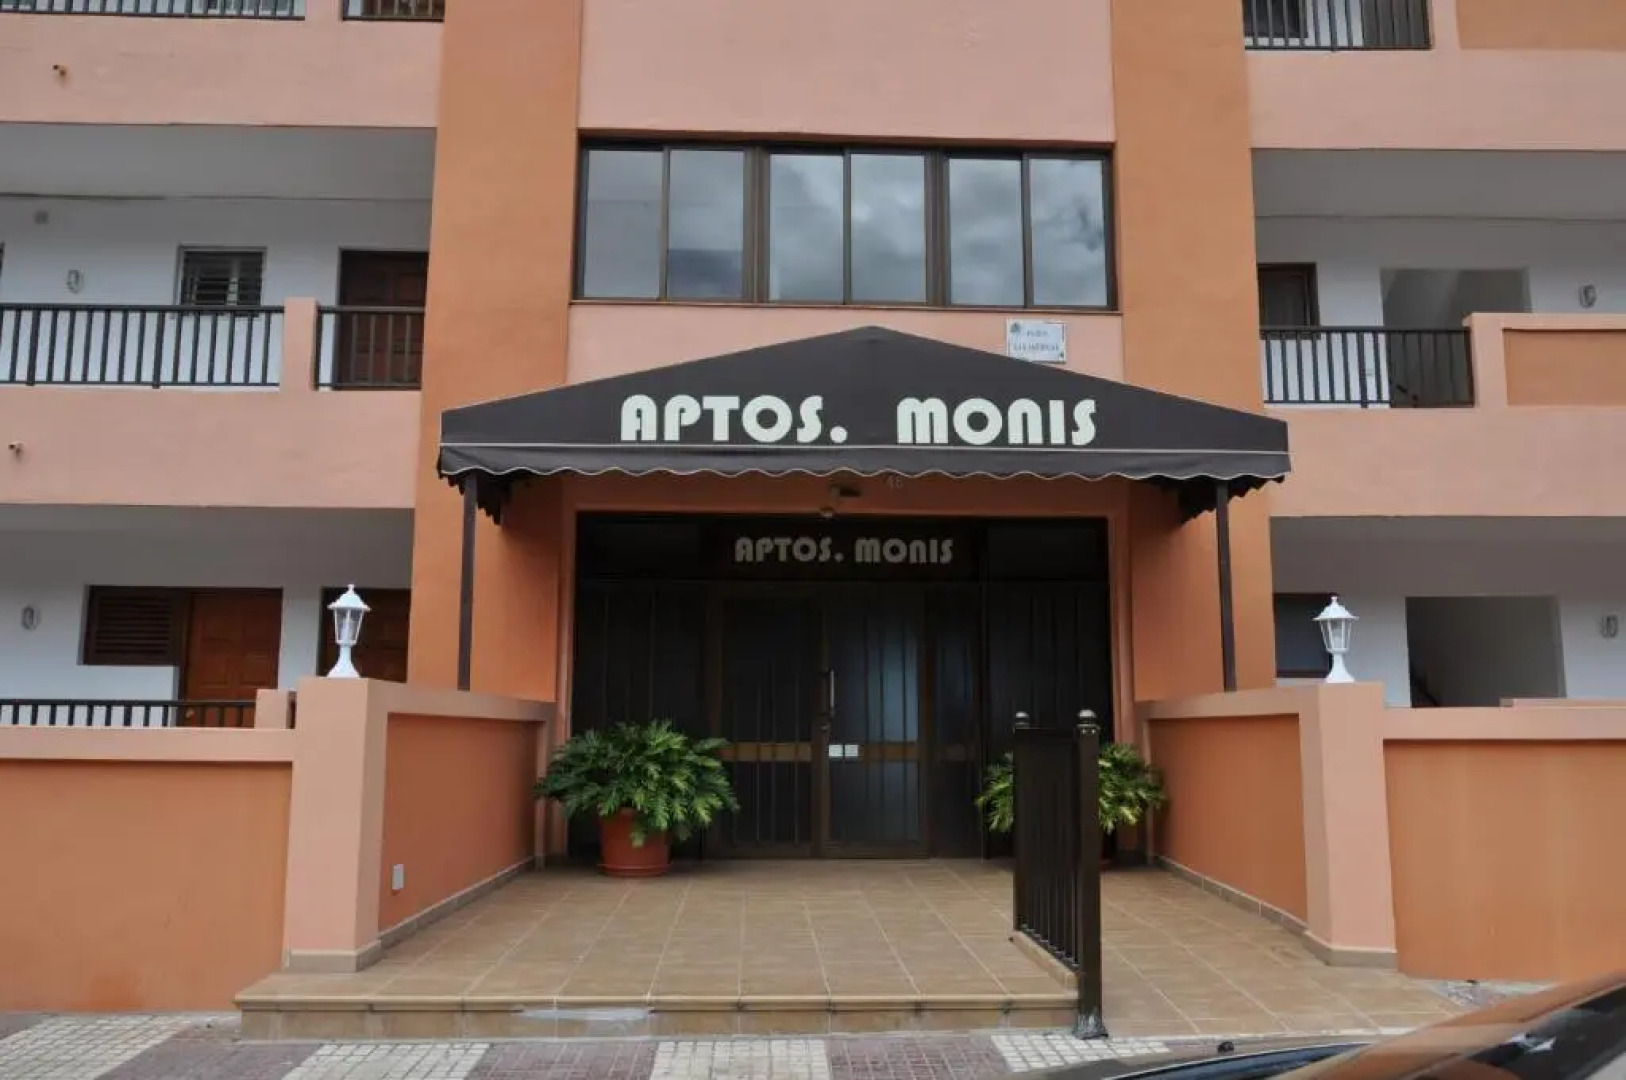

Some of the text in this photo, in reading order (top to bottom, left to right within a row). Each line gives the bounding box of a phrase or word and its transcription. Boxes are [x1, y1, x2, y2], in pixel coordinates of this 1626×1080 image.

[621, 394, 1096, 446] APTOS. MONIS
[735, 536, 953, 564] APTOS. MONIS
